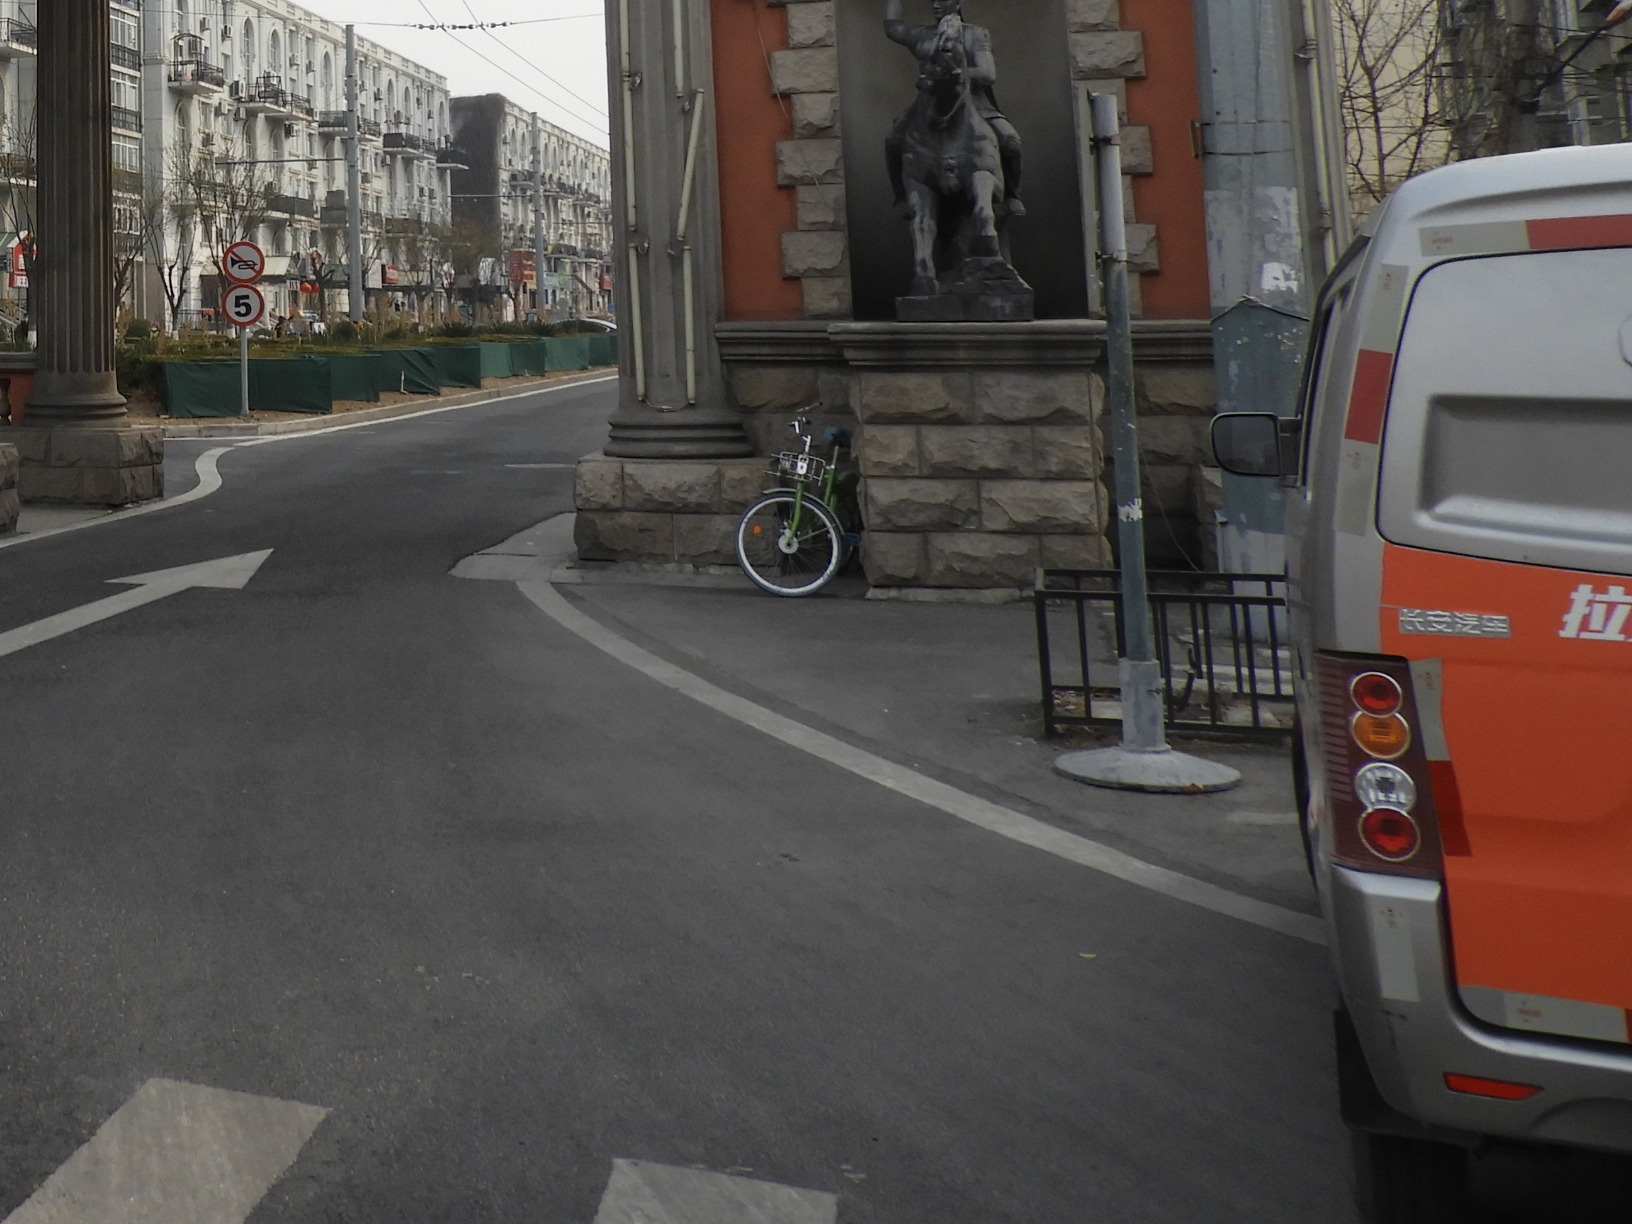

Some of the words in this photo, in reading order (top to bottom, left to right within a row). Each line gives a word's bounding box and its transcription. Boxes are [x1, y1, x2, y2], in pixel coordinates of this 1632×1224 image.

[234, 295, 252, 317] 5
[1399, 608, 1509, 635] 长安汽车
[1558, 584, 1632, 643] 拉
